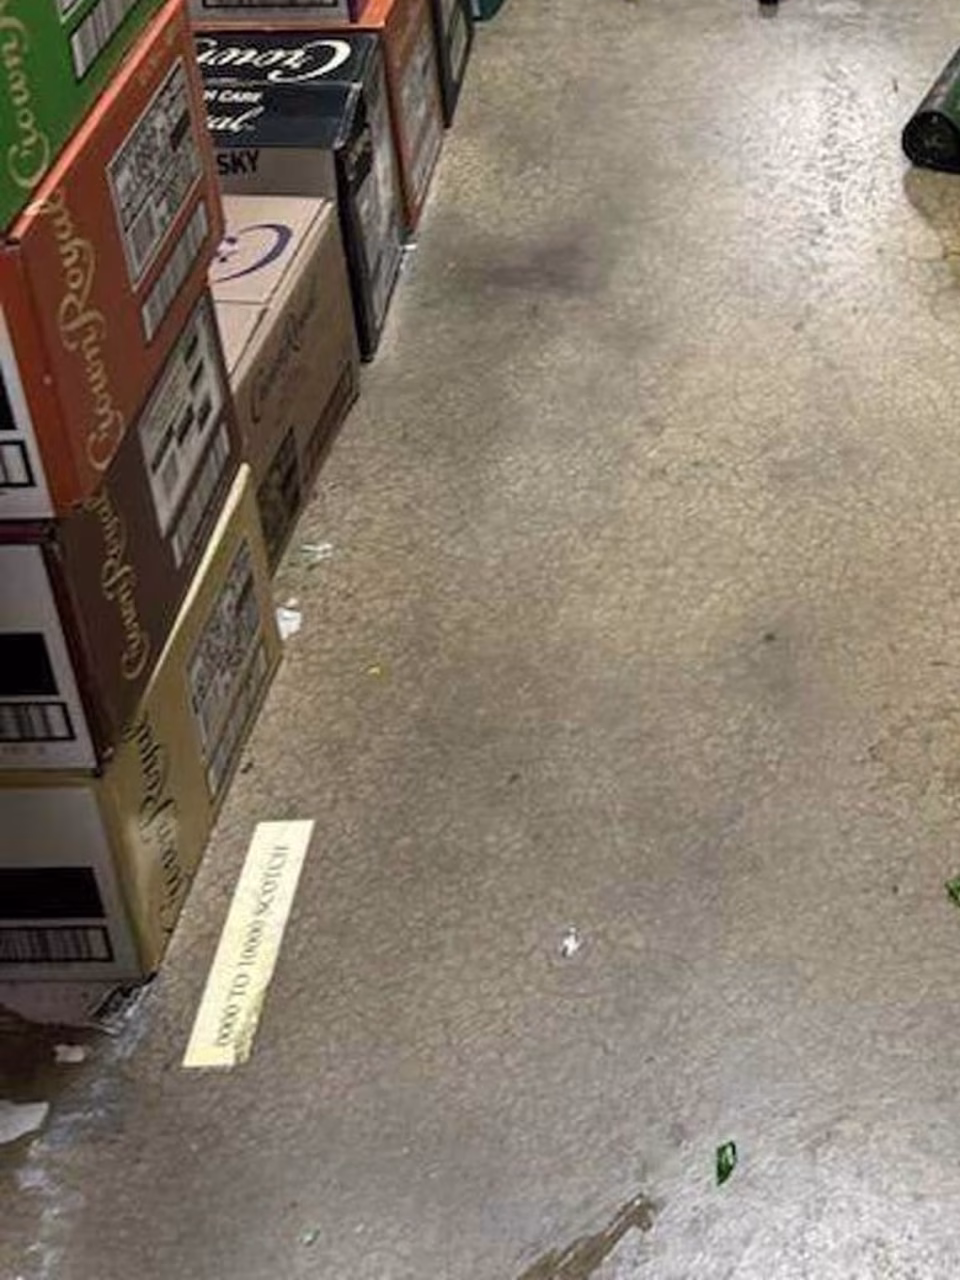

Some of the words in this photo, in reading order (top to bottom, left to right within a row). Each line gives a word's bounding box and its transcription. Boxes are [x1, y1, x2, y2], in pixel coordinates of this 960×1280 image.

[217, 149, 260, 174] SKY
[229, 970, 252, 999] TO
[253, 843, 291, 917] SCOTCH
